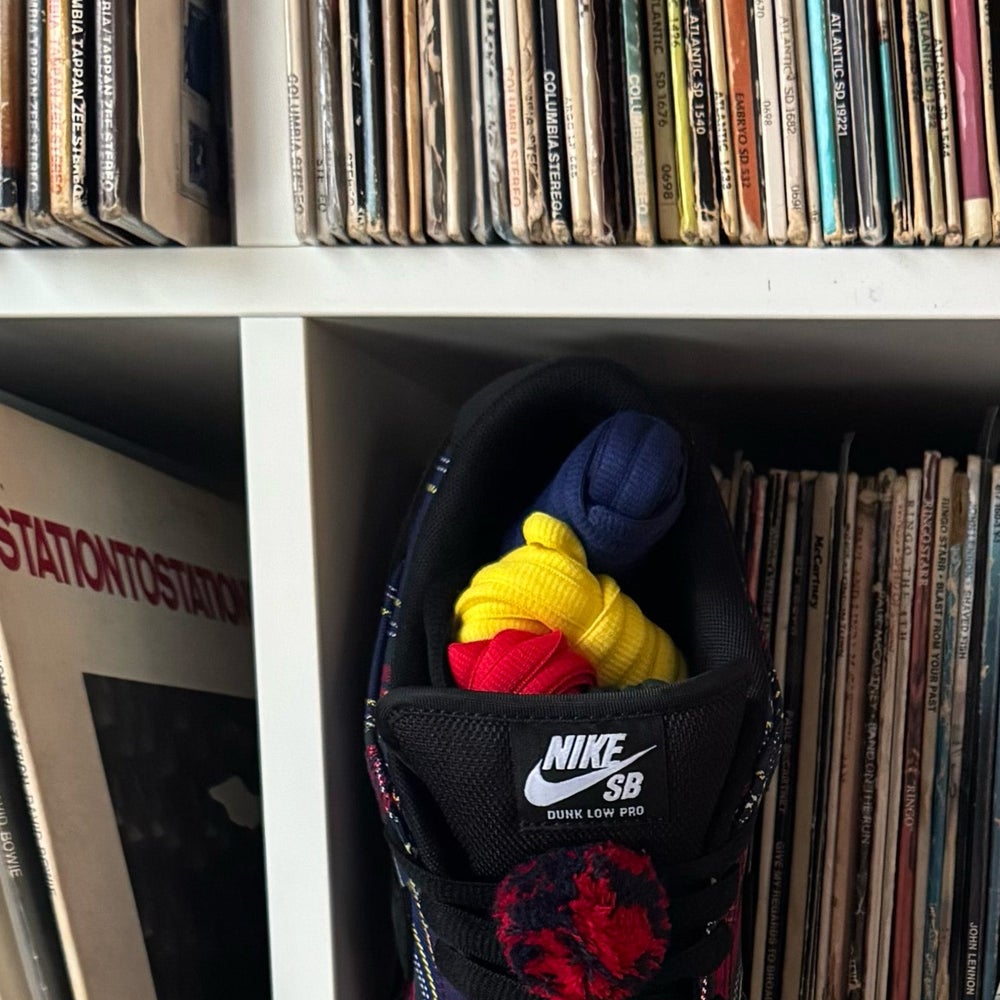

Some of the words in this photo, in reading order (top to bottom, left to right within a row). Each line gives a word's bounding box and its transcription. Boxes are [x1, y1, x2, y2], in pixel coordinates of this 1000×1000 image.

[689, 15, 703, 77] ATLANTIC
[781, 17, 793, 74] ATLANTIC
[831, 13, 844, 77] ATLANTIC
[918, 11, 933, 72] ATLANTIC
[72, 38, 84, 99] TAPPAN
[655, 72, 665, 89] SD
[925, 76, 935, 92] SD
[505, 68, 517, 145] COLUMBIA
[692, 82, 704, 98] SD
[784, 87, 794, 104] SD
[835, 82, 846, 100] SD
[72, 103, 83, 132] ZEE
[288, 74, 301, 150] COLUMBIA
[544, 70, 558, 149] COLUMBIA
[629, 74, 643, 155] COLUMBIA
[657, 95, 668, 127] 1676
[694, 104, 706, 135] 1540
[735, 92, 747, 145] EMBRYO
[785, 108, 796, 135] 1682
[837, 103, 847, 137] 19221
[739, 148, 749, 163] SD
[292, 156, 304, 214] STEREO
[509, 149, 521, 207] STEREO
[548, 154, 562, 212] STEREO
[662, 164, 674, 199] 0698
[741, 168, 751, 188] 532
[903, 499, 915, 557] RINGO
[937, 537, 948, 571] STARR
[809, 535, 825, 610] McCartney
[933, 582, 944, 616] BLAST
[960, 589, 972, 633] SHAVED
[931, 619, 942, 650] FROM
[958, 635, 969, 660] FISH
[930, 653, 941, 682] YOUR
[927, 685, 939, 713] PAST
[542, 733, 628, 770] NIKE
[603, 771, 644, 802] SB
[547, 809, 583, 820] DUNK
[587, 808, 615, 818] LOW
[619, 806, 645, 817] PRO
[860, 816, 872, 845] RUN
[0, 832, 22, 878] BOWIE
[968, 922, 978, 950] JOHN
[966, 953, 977, 995] LENNON
